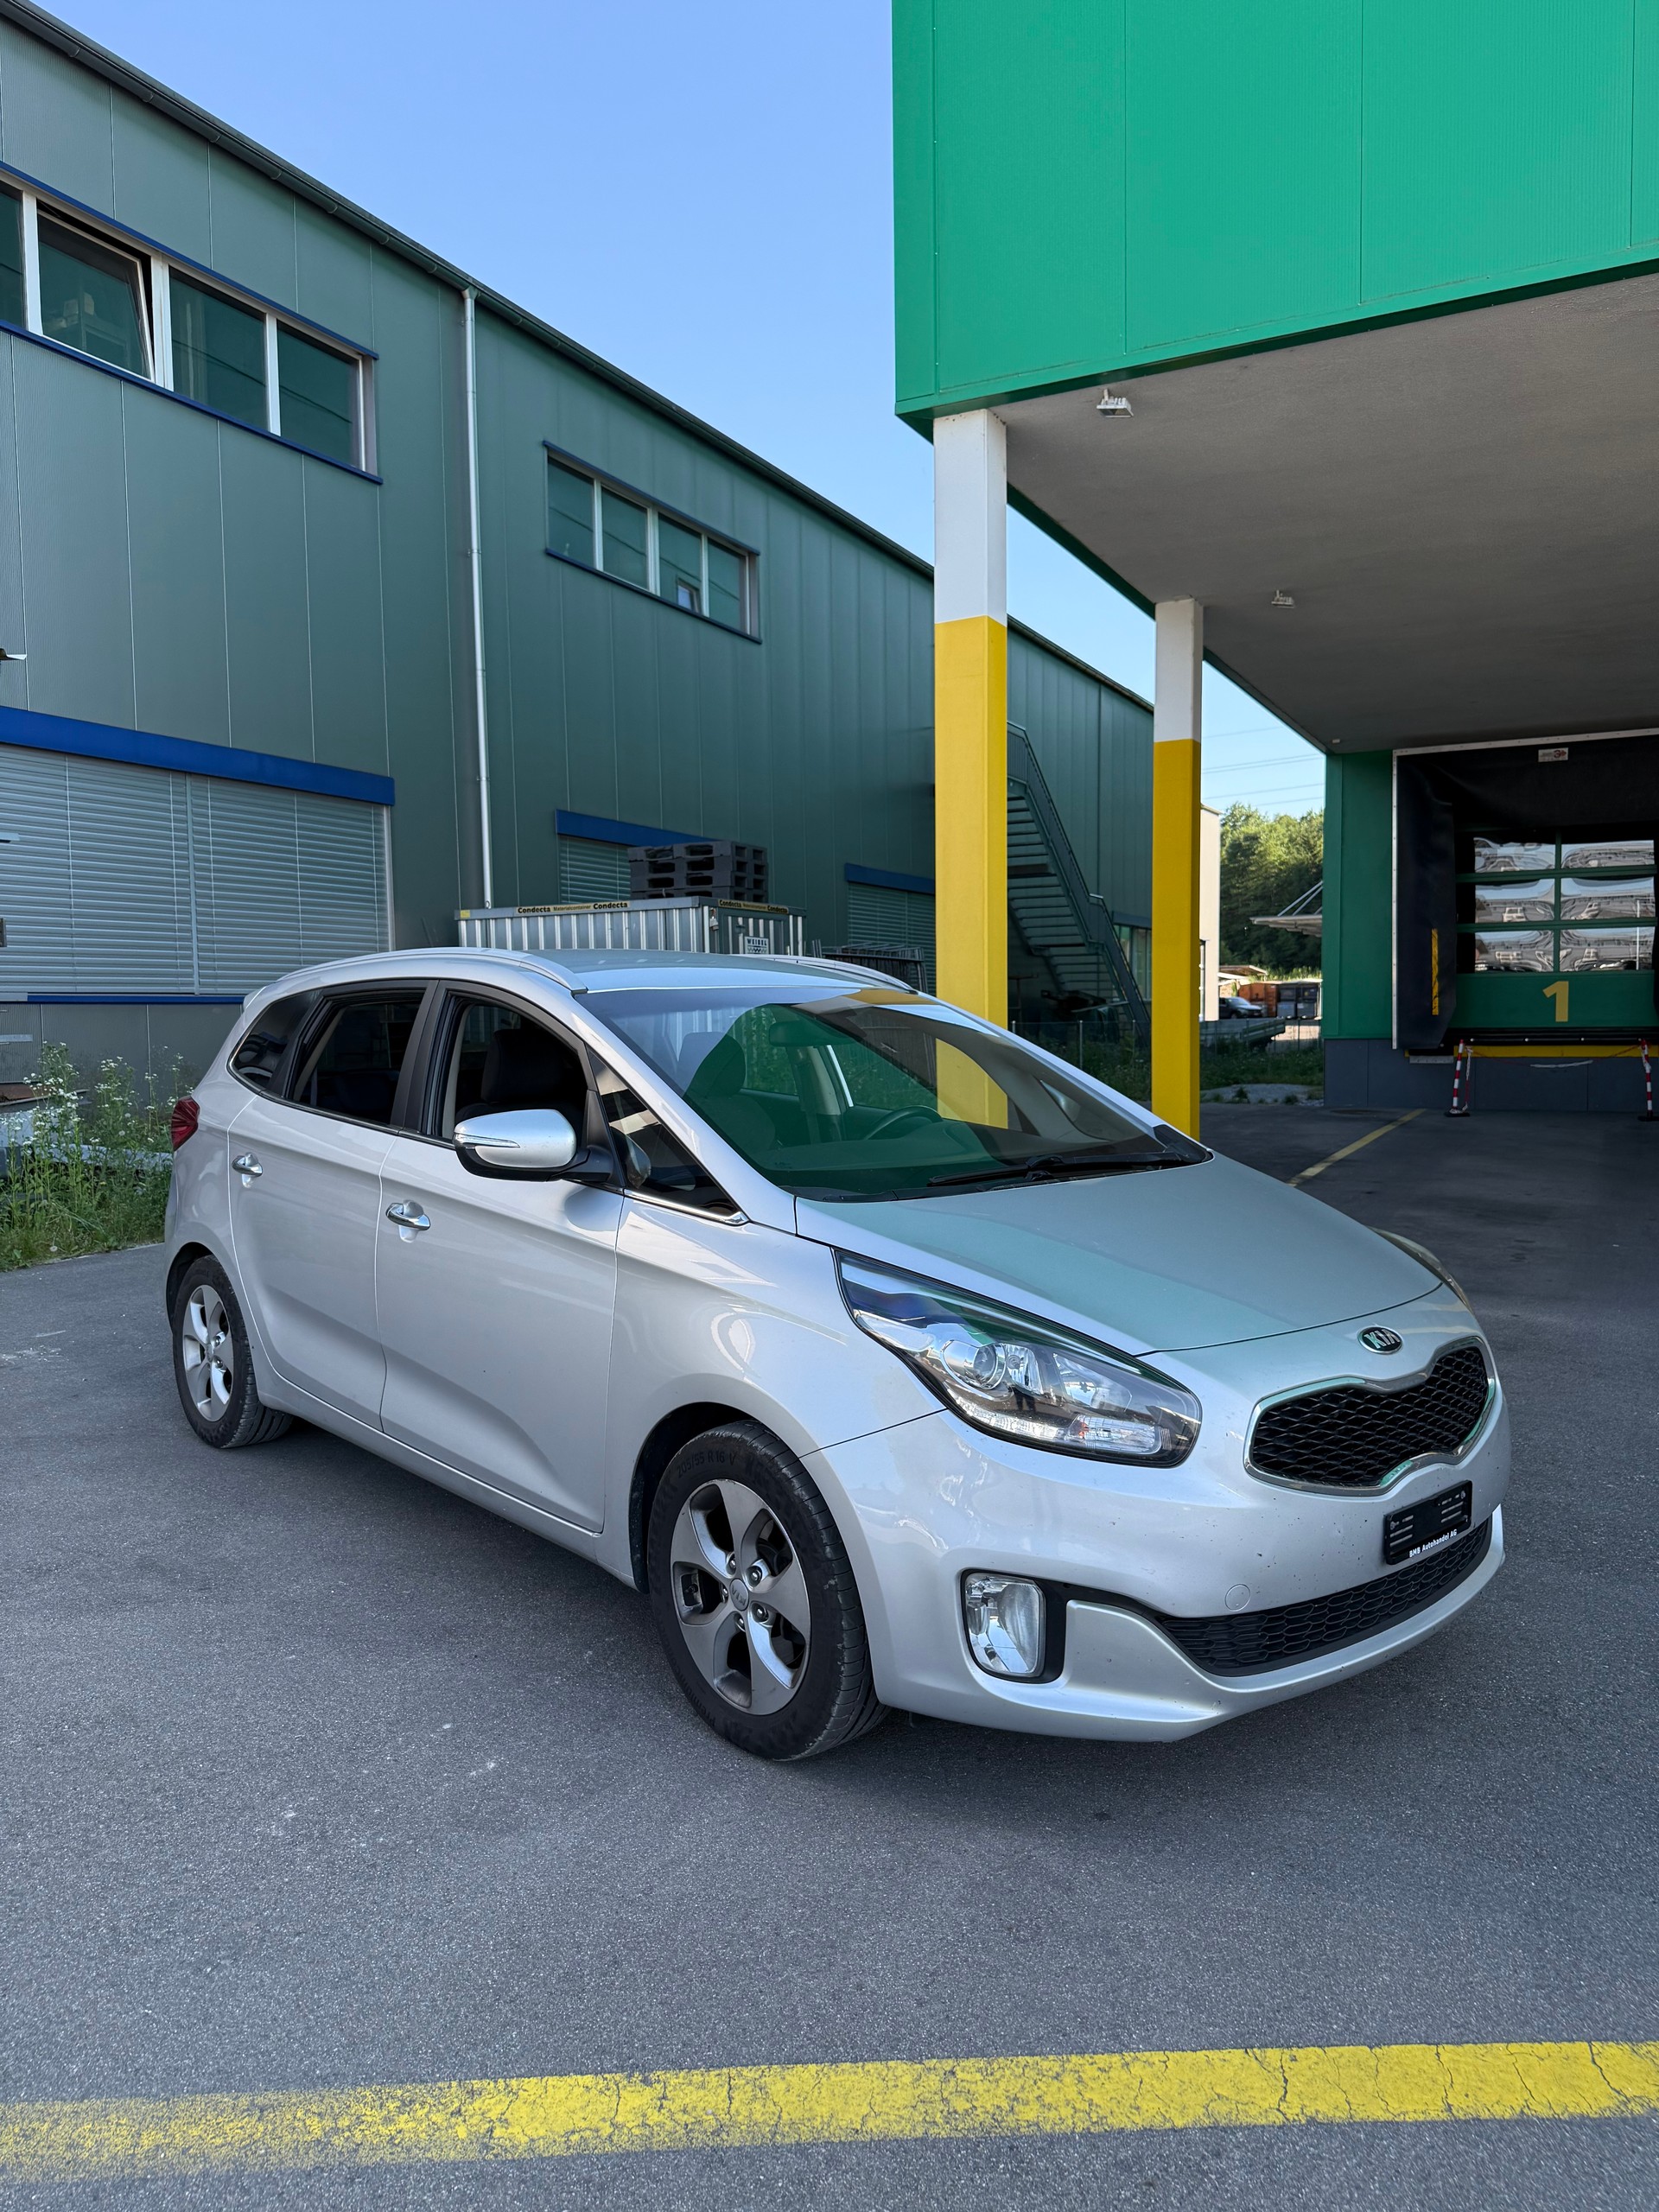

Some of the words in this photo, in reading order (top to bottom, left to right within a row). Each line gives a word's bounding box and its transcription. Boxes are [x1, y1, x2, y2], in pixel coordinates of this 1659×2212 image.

[719, 899, 742, 908] Condecta
[1542, 981, 1569, 1022] 1
[1363, 1329, 1401, 1349] KIA
[677, 1452, 705, 1478] 205/55
[1409, 1547, 1421, 1558] BMB
[1422, 1532, 1450, 1552] Autohandel
[1450, 1529, 1458, 1538] AG
